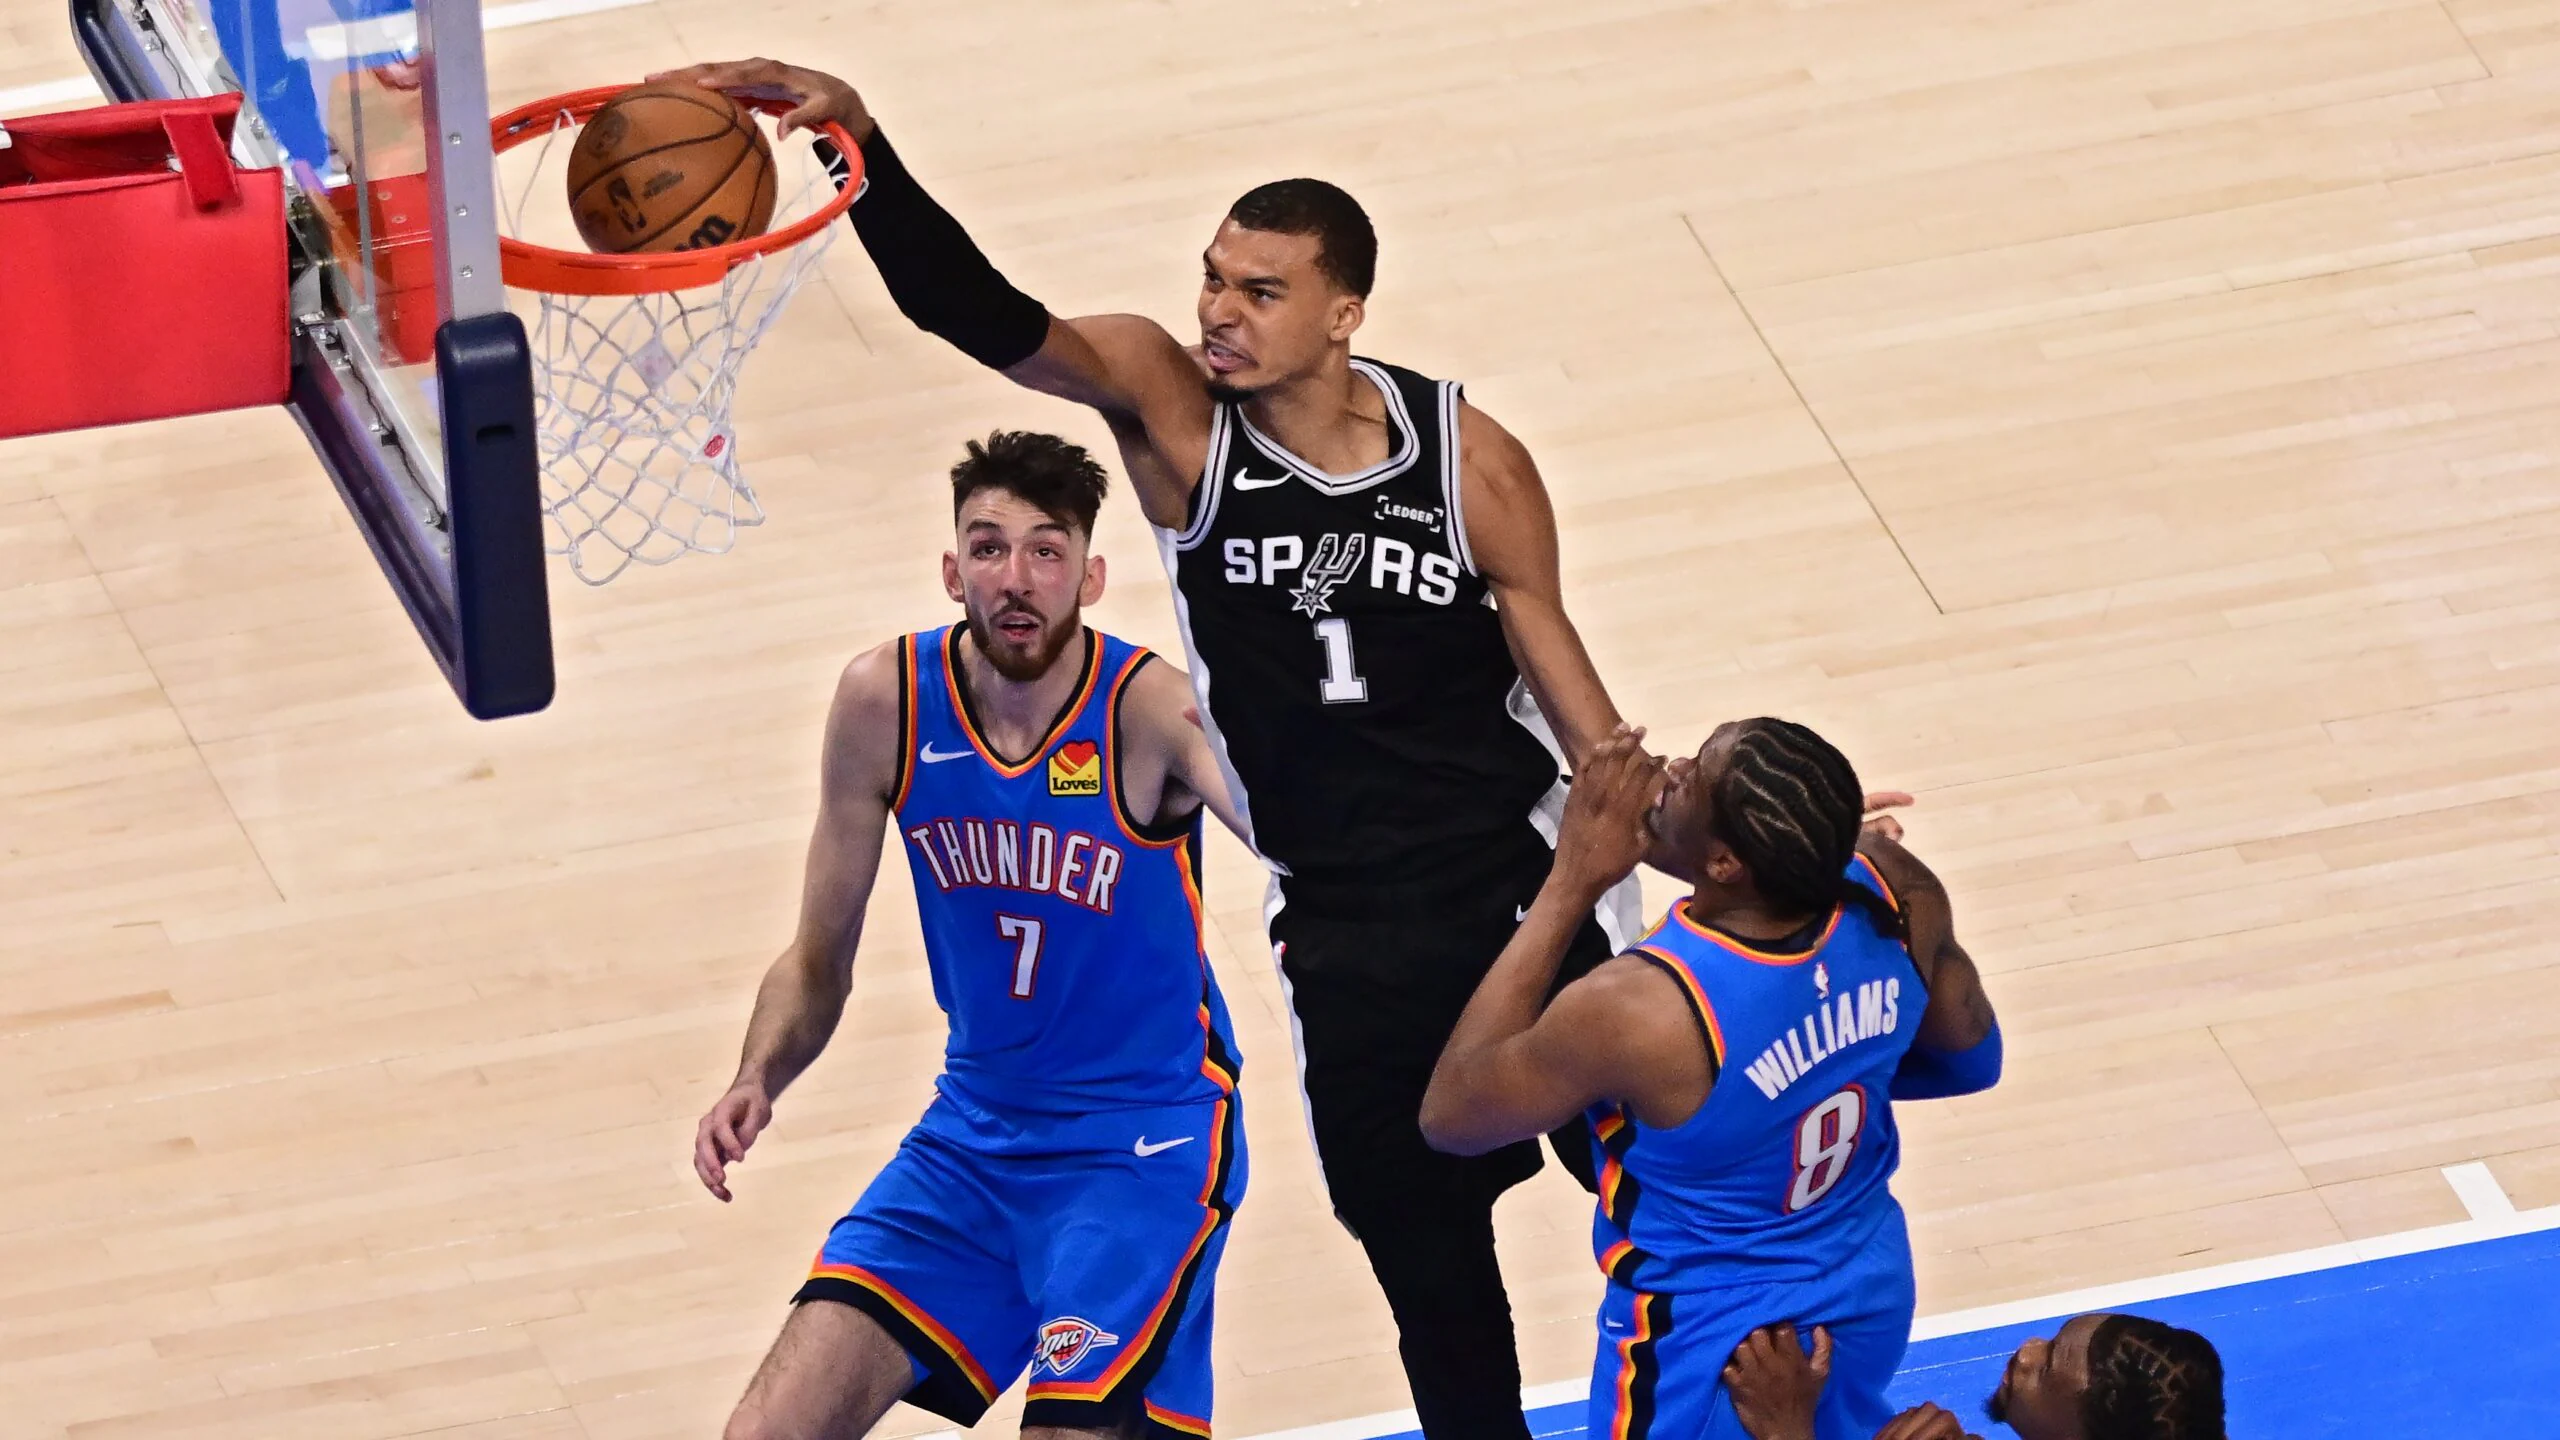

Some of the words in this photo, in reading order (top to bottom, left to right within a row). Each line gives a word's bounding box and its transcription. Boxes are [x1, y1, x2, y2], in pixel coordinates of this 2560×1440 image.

[1383, 502, 1434, 525] LEDGER
[1223, 533, 1460, 618] SPURS
[1312, 616, 1369, 705] 1
[908, 817, 1124, 914] THUNDER
[997, 912, 1045, 1000] 7
[1744, 976, 1900, 1101] WILLIAMS
[1785, 1083, 1867, 1216] 8
[1040, 1329, 1082, 1361] OKC
